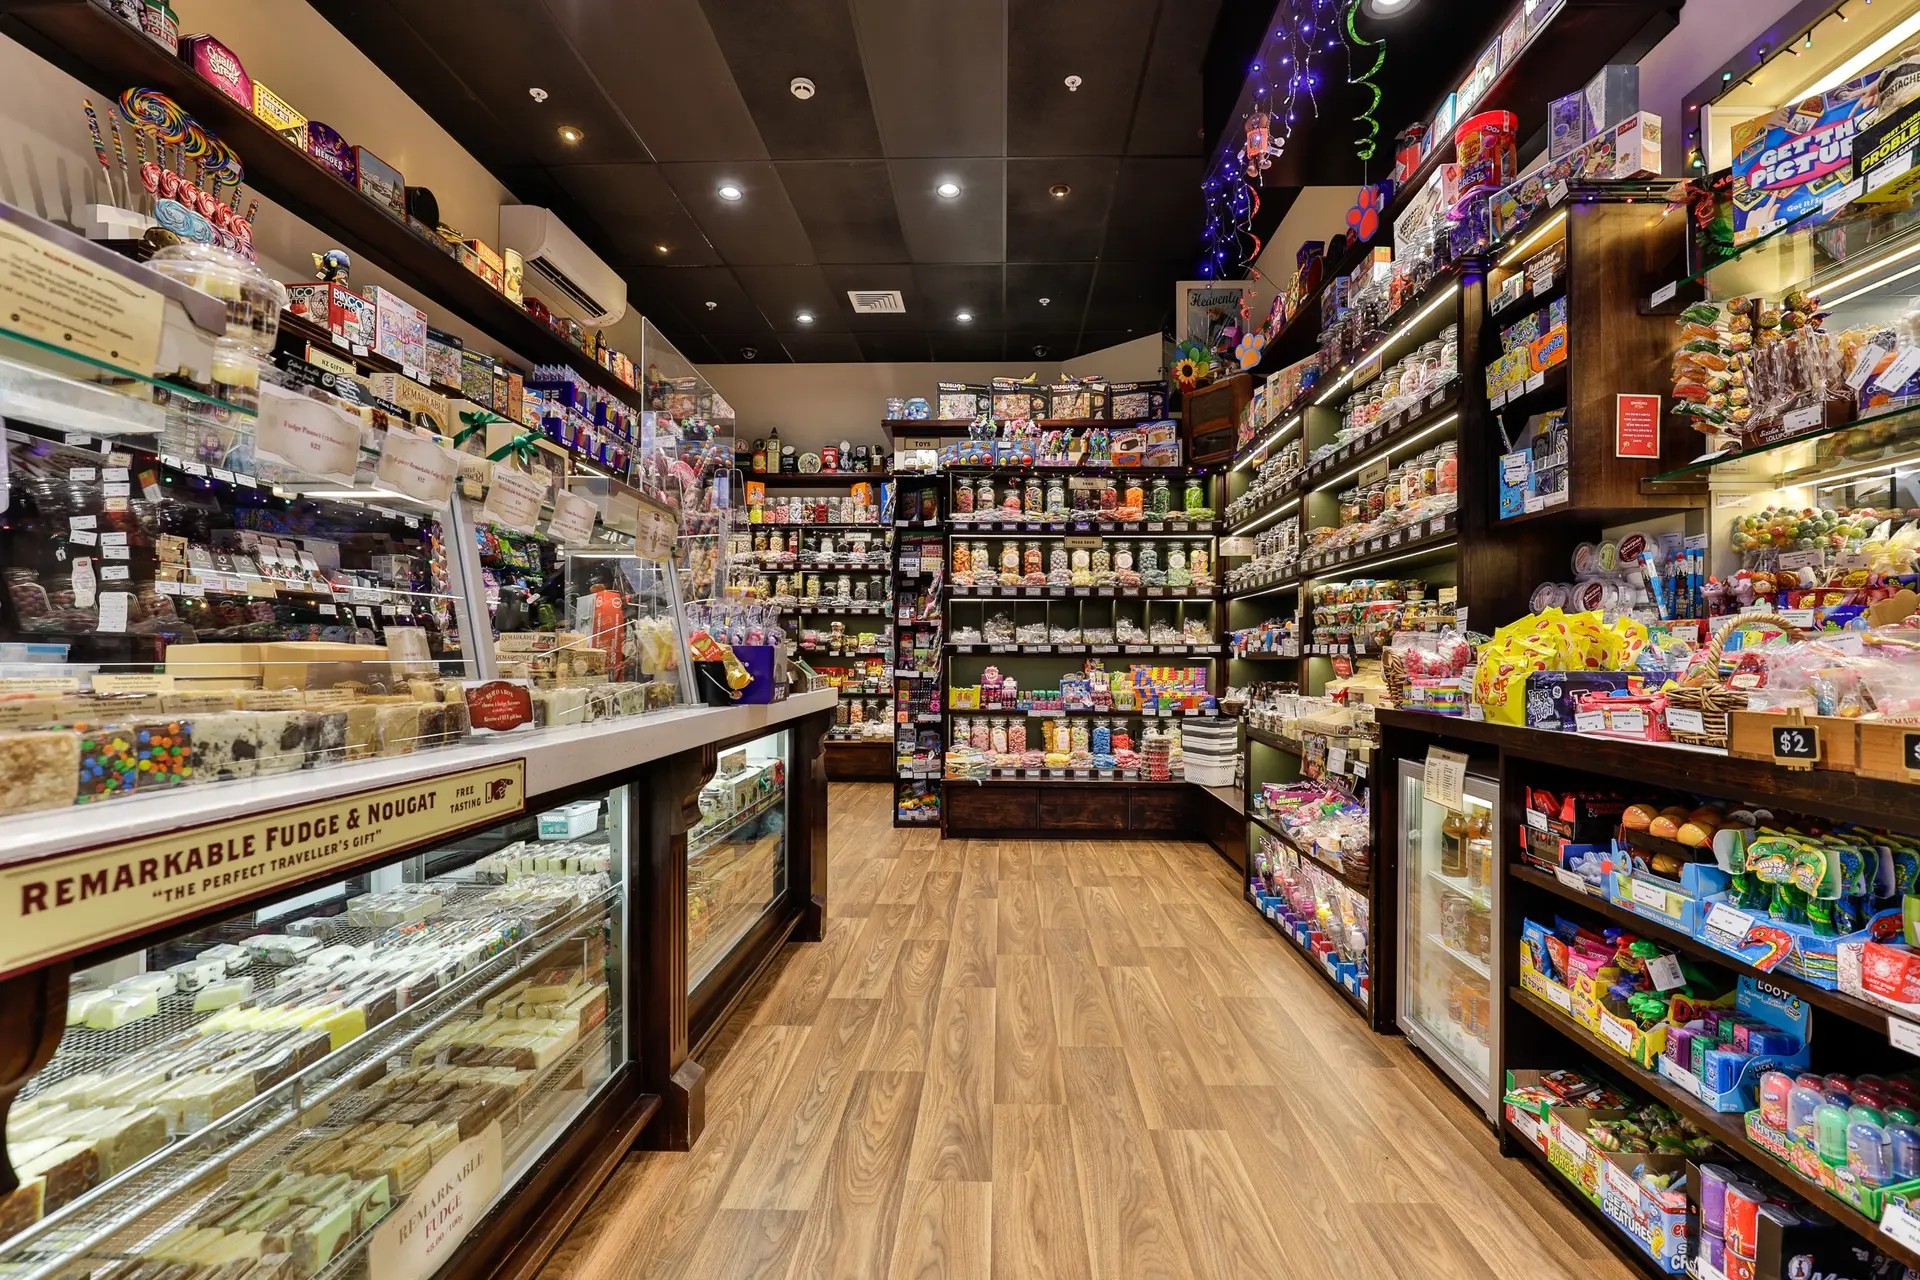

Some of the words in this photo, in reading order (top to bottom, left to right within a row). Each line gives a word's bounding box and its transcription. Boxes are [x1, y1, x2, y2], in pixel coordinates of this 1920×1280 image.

[206, 44, 239, 75] Quality
[210, 59, 240, 85] Street
[1759, 135, 1814, 168] GET
[1815, 118, 1855, 146] TH
[1861, 121, 1920, 172] PROBLE
[315, 146, 343, 172] HEROES
[1525, 250, 1556, 277] Junior
[286, 287, 314, 298] INGO
[333, 288, 364, 309] BINGO
[1190, 292, 1239, 308] Heavenly
[321, 359, 330, 367] NZ
[331, 363, 345, 373] GIFTS
[401, 384, 445, 414] REMARKABLE
[543, 389, 559, 399] EZ
[574, 402, 584, 412] PEZ
[1780, 731, 1808, 754] $2
[455, 786, 475, 799] FREE
[449, 797, 482, 815] TASTING
[20, 834, 256, 917] REMARKABLE
[266, 814, 340, 853] FUDGE
[346, 808, 360, 829] &
[368, 791, 437, 825] NOUGAT
[202, 865, 265, 893] PERFECT
[270, 838, 349, 872] TRAVELLER'S
[1757, 980, 1790, 1001] LOOT
[1747, 1126, 1790, 1162] DIPPERS
[1751, 1116, 1785, 1148] THUMB
[1550, 1148, 1579, 1179] BURGER
[399, 1149, 485, 1244] REMARKABLE
[1606, 1190, 1629, 1213] SEA
[425, 1192, 462, 1239] FUDGE
[1603, 1198, 1653, 1244] CREATURES
